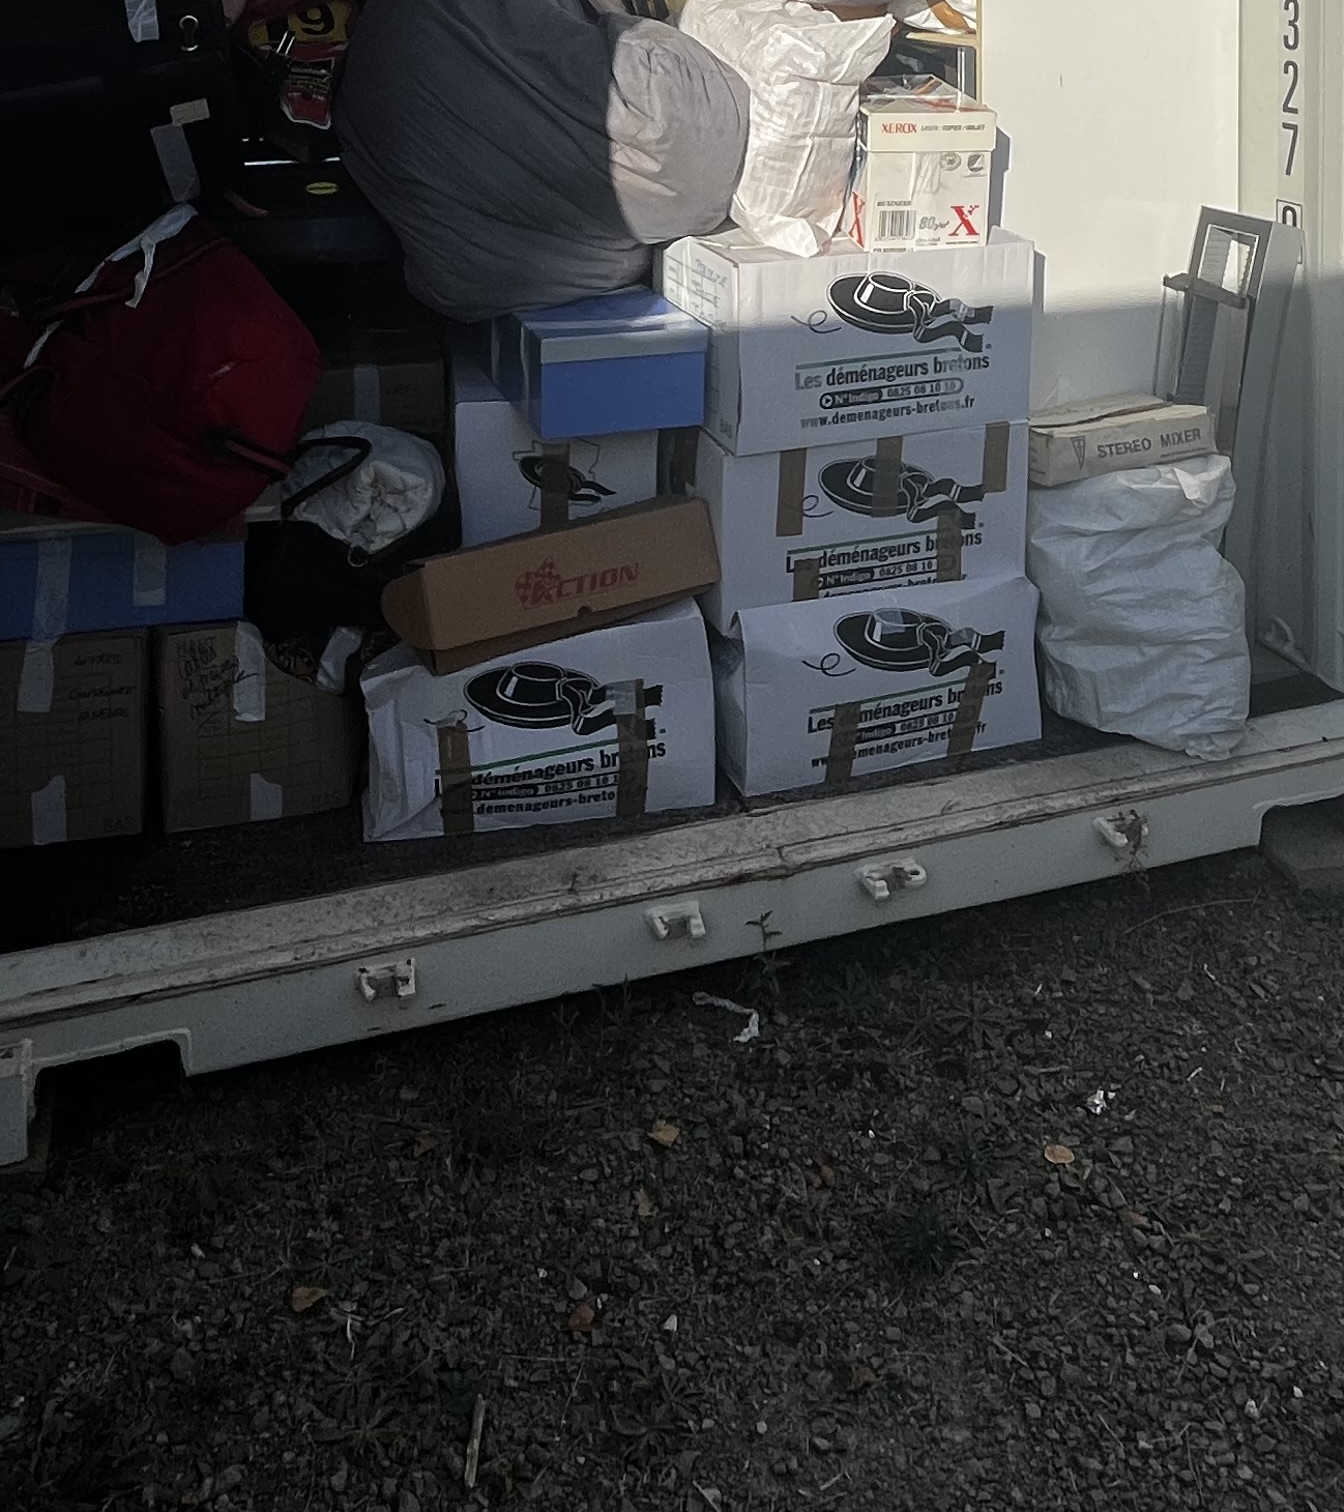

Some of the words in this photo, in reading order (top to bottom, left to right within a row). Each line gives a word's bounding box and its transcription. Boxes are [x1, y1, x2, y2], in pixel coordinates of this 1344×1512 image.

[881, 122, 918, 134] XEROX
[794, 371, 822, 390] Les
[826, 361, 929, 387] déménageurs
[933, 355, 990, 375] bretons
[929, 384, 941, 393] 10
[800, 395, 975, 429] www.demenageurs-bretons.fr
[1097, 437, 1152, 459] STEREO
[1160, 428, 1202, 448] MIXER
[819, 540, 921, 568] déménageurs
[879, 564, 903, 577] 0825
[921, 560, 933, 571] 10
[807, 716, 834, 734] Les
[858, 692, 944, 724] ménageurs
[471, 756, 594, 786] déménageurs
